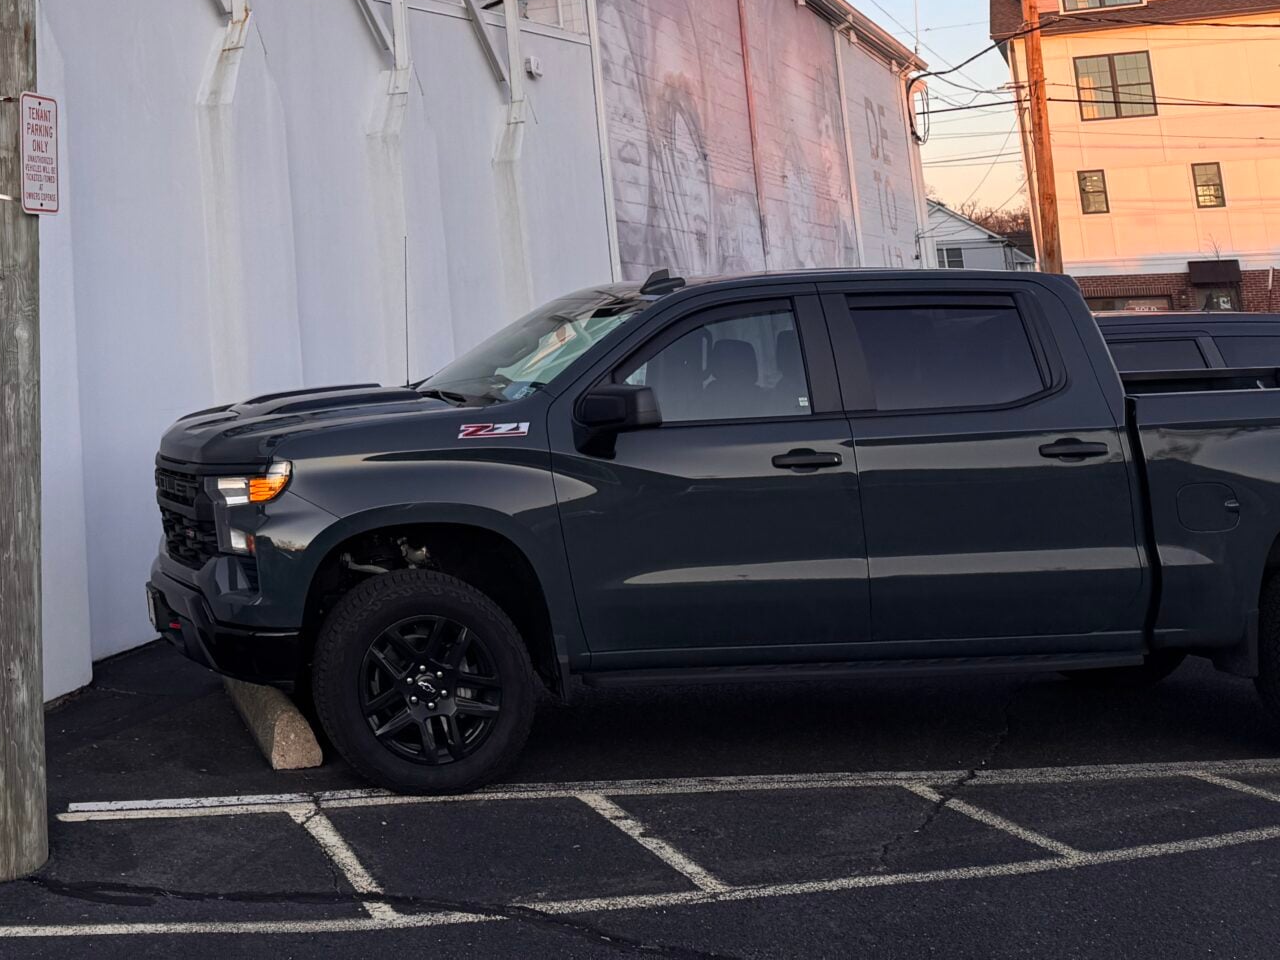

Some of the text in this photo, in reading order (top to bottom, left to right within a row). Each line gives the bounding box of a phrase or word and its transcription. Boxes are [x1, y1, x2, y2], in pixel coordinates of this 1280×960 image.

[28, 107, 51, 122] TENANT
[26, 122, 53, 139] PARKING
[32, 139, 49, 154] ONLY
[28, 155, 53, 165] UNAUTHORIZED
[26, 164, 42, 173] VEHICLES
[42, 165, 51, 174] WILL
[41, 193, 56, 201] EXPENSE
[458, 422, 530, 439] Z71
